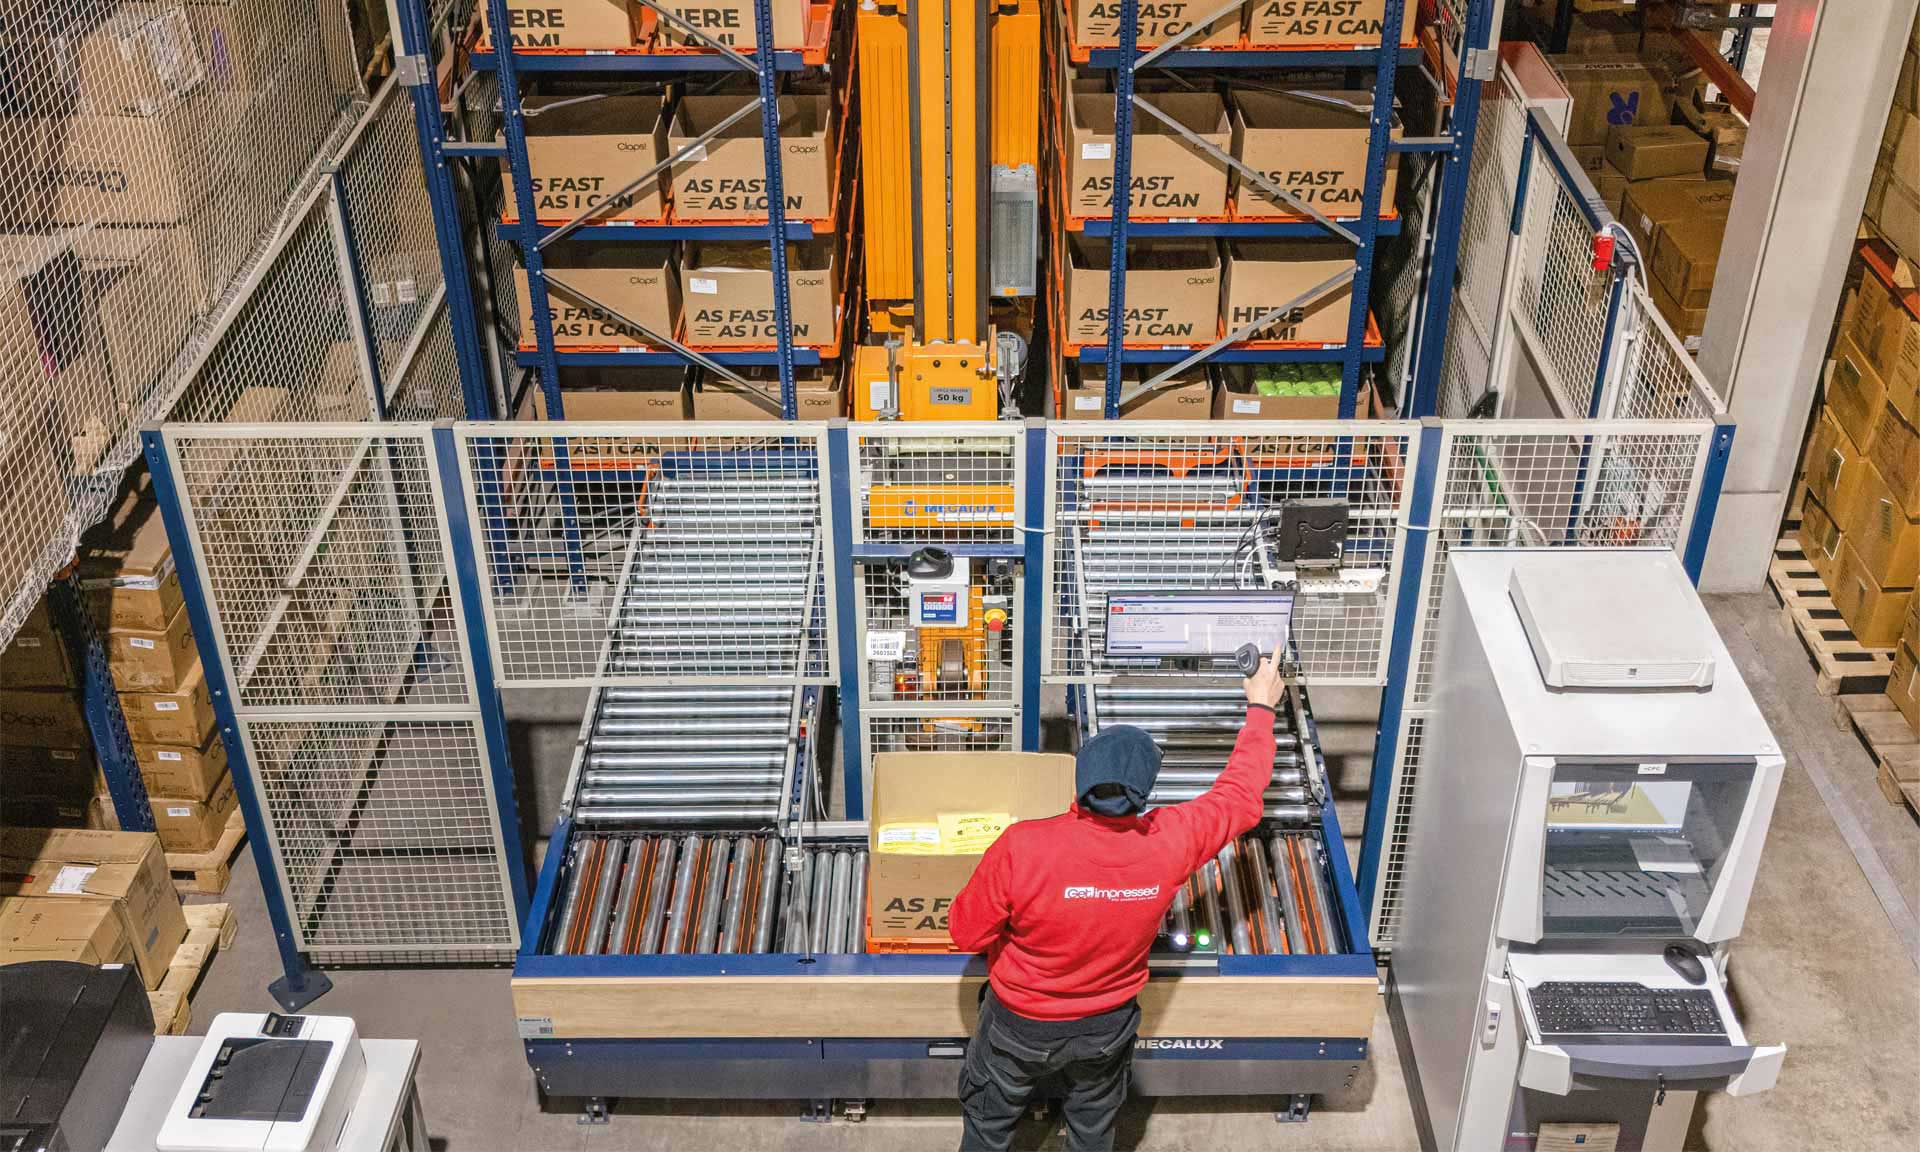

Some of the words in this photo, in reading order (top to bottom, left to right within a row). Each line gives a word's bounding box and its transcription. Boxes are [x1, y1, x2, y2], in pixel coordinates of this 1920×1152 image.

[1264, 2, 1296, 16] AS
[1301, 1, 1361, 16] FAST
[486, 9, 565, 28] ERE
[1150, 22, 1158, 36] I
[1286, 20, 1319, 35] AS
[1323, 20, 1331, 35] I
[1337, 20, 1383, 35] CAN
[549, 177, 604, 192] FAST
[1081, 177, 1113, 190] AS
[1129, 177, 1174, 190] AST
[1286, 171, 1344, 185] FAST
[684, 179, 713, 193] AS
[539, 195, 568, 209] AS
[574, 195, 580, 209] I
[1139, 194, 1147, 207] I
[1152, 194, 1199, 207] CAN
[1307, 189, 1316, 202] I
[707, 196, 737, 210] AS
[695, 310, 723, 322] AS
[1080, 308, 1110, 320] AS
[554, 324, 582, 336] AS
[588, 324, 594, 336] I
[717, 325, 747, 337] AS
[752, 325, 759, 337] I
[1135, 323, 1142, 336] I
[1147, 323, 1193, 336] CAN
[937, 393, 950, 401] 50
[952, 394, 964, 403] kg
[884, 898, 925, 912] AS
